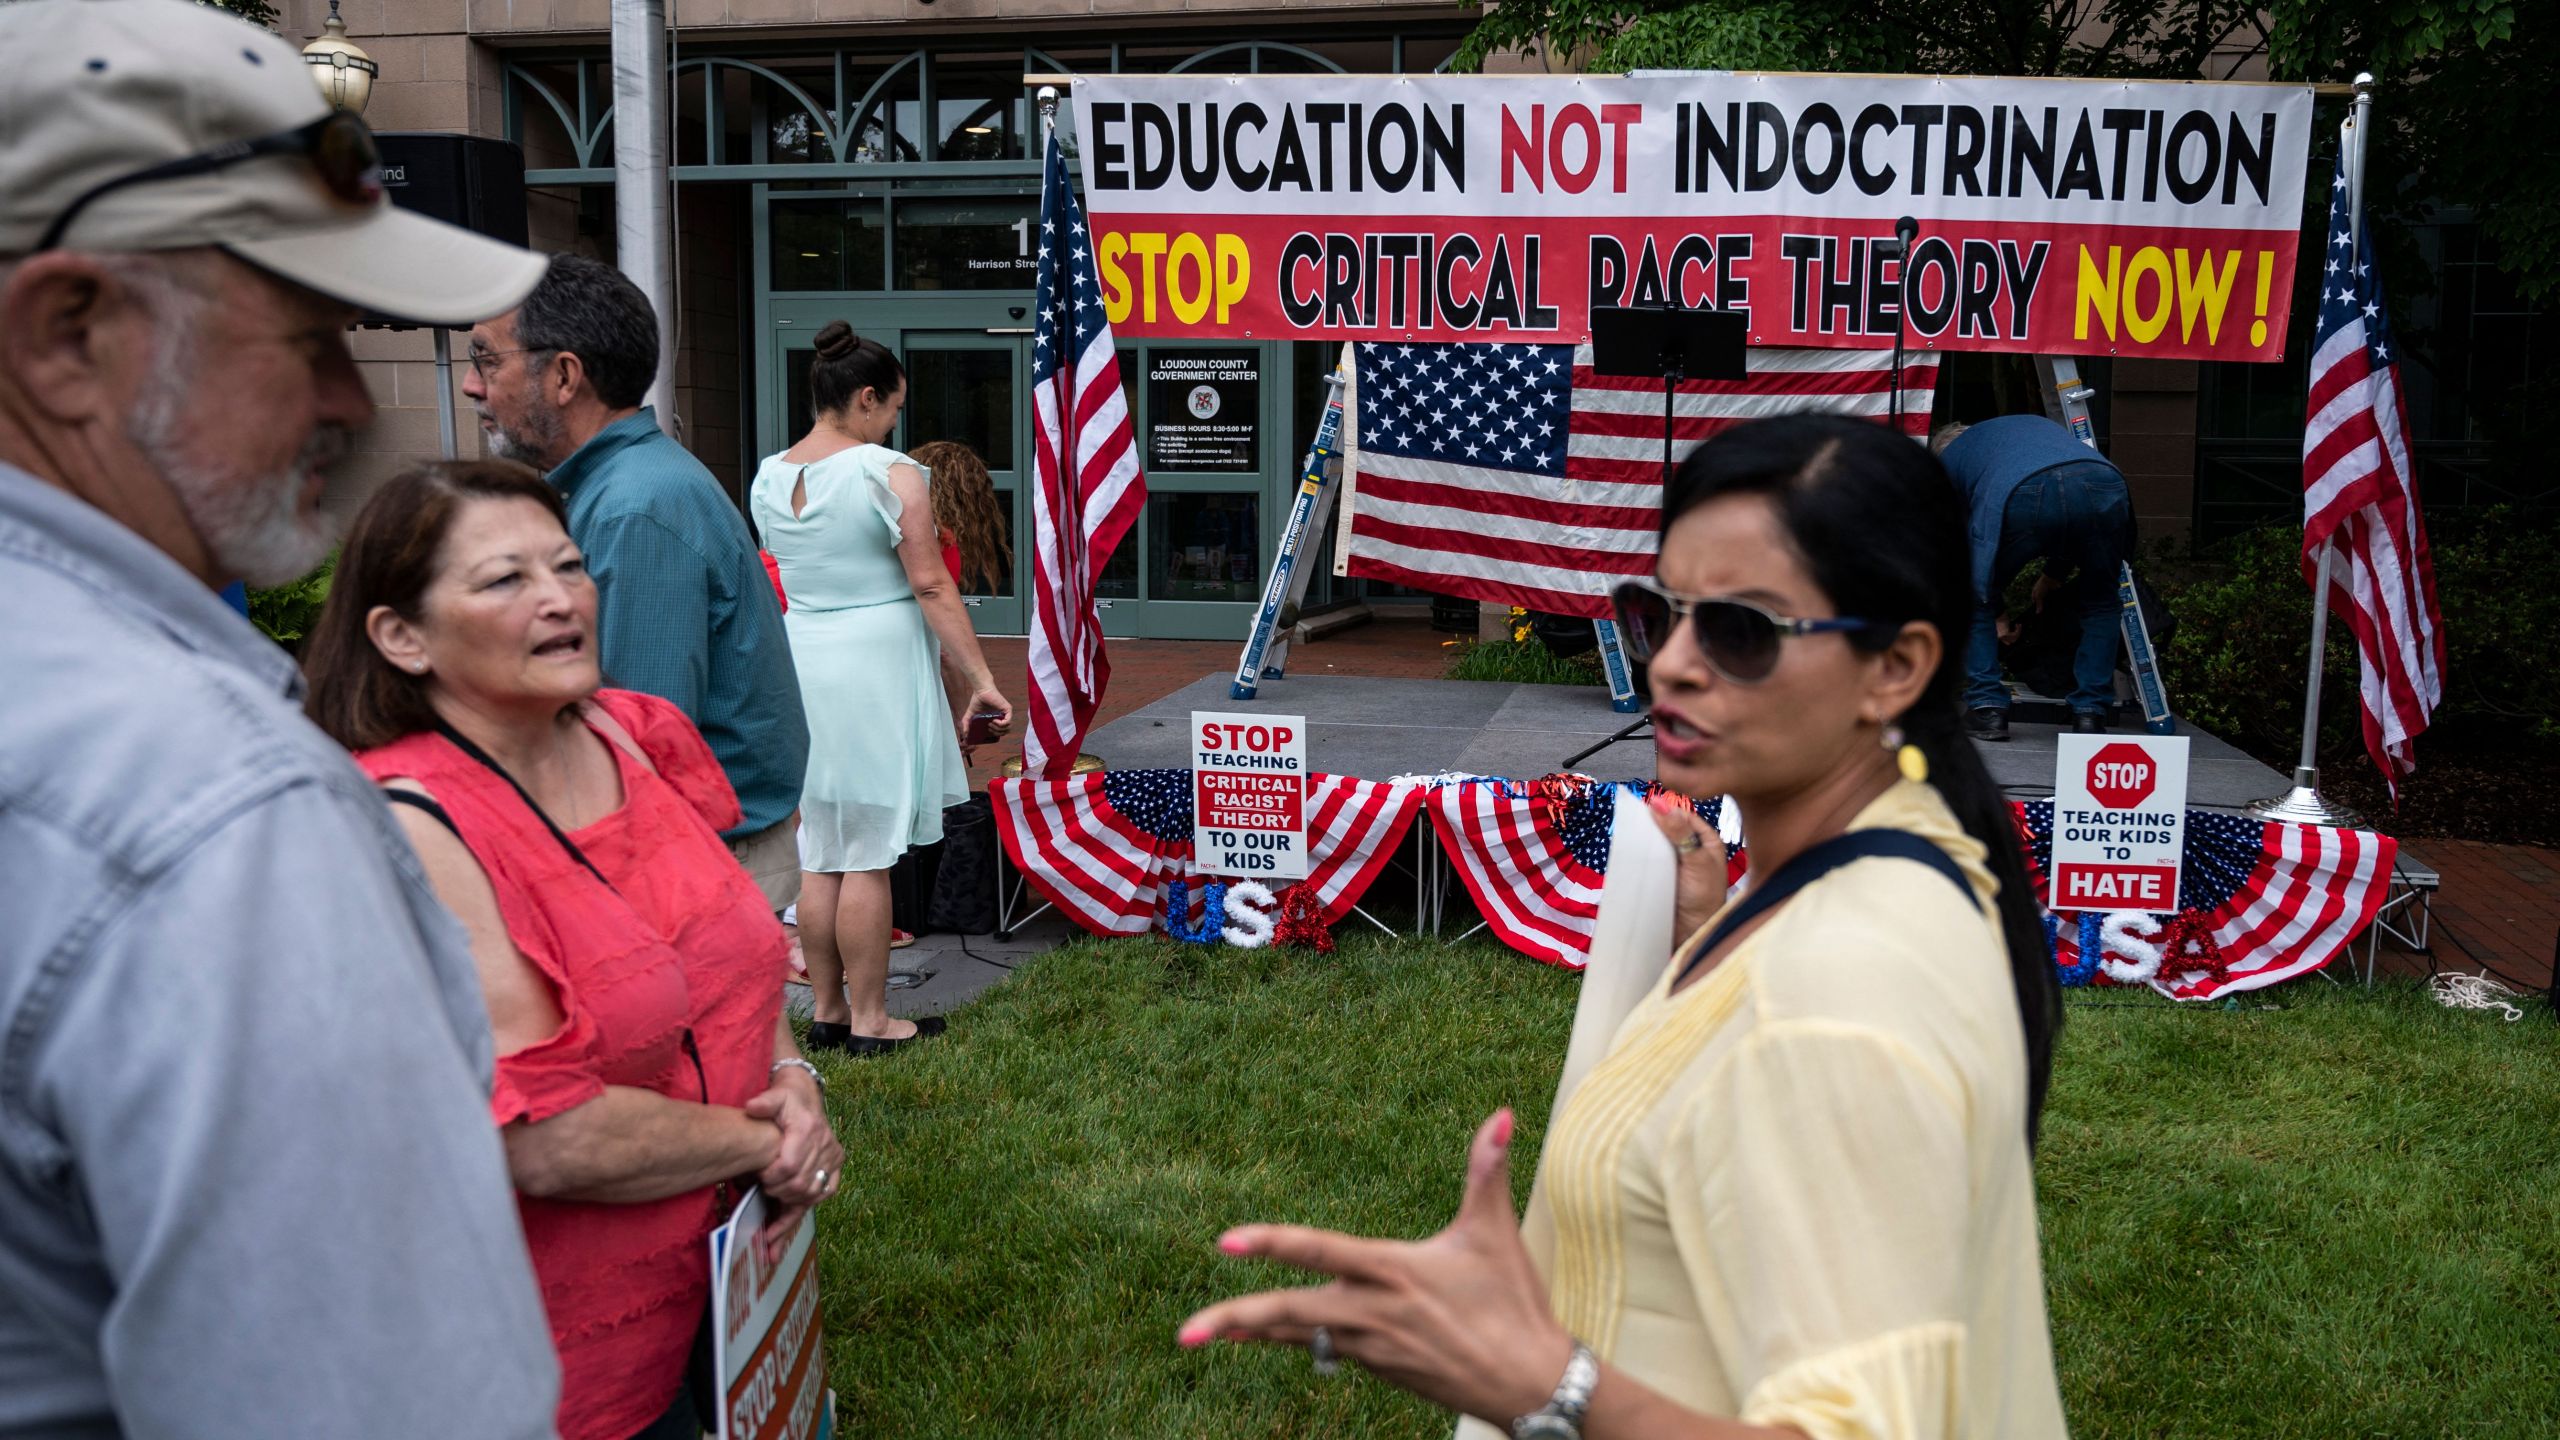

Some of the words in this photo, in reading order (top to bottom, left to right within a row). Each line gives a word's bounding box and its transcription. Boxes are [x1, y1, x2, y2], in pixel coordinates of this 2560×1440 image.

[1091, 102, 1465, 193] EDUCATION
[1501, 103, 1642, 194] NOT
[1675, 101, 2277, 207] INDOCTRINATION
[1011, 218, 1028, 256] 1
[969, 260, 1011, 269] Harrison
[1100, 231, 1250, 325] STOP
[1278, 231, 1559, 332] CRITICAL
[1589, 232, 1753, 332] RACE
[1781, 234, 2050, 339] THEORY
[1160, 360, 1207, 369] LOUDOUN
[1209, 360, 1248, 369] COUNTY
[1151, 371, 1217, 380] GOVERNMENT
[1219, 371, 1257, 380] CENTER
[1283, 509, 1303, 556] MULTI-POSITION
[1298, 497, 1308, 511] PRO
[1271, 572, 1285, 603] WERNER
[1201, 723, 1293, 752] STOP
[1199, 753, 1298, 769] TEACHING
[1203, 775, 1297, 793] CRITICAL
[2094, 763, 2149, 789] STOP
[1214, 792, 1287, 808] RACIST
[1210, 811, 1292, 828] THEORY
[2063, 810, 2176, 827] TEACHING
[1208, 831, 1237, 848] TO
[1244, 833, 1291, 851] OUR
[2065, 828, 2111, 842] OUR
[2119, 830, 2171, 844] KIDS
[1224, 852, 1275, 870] KIDS
[2103, 847, 2131, 860] TO
[2069, 872, 2161, 899] HATE
[1167, 880, 1335, 955] USA
[2041, 907, 2232, 987] USA
[733, 1350, 776, 1440] STOP
